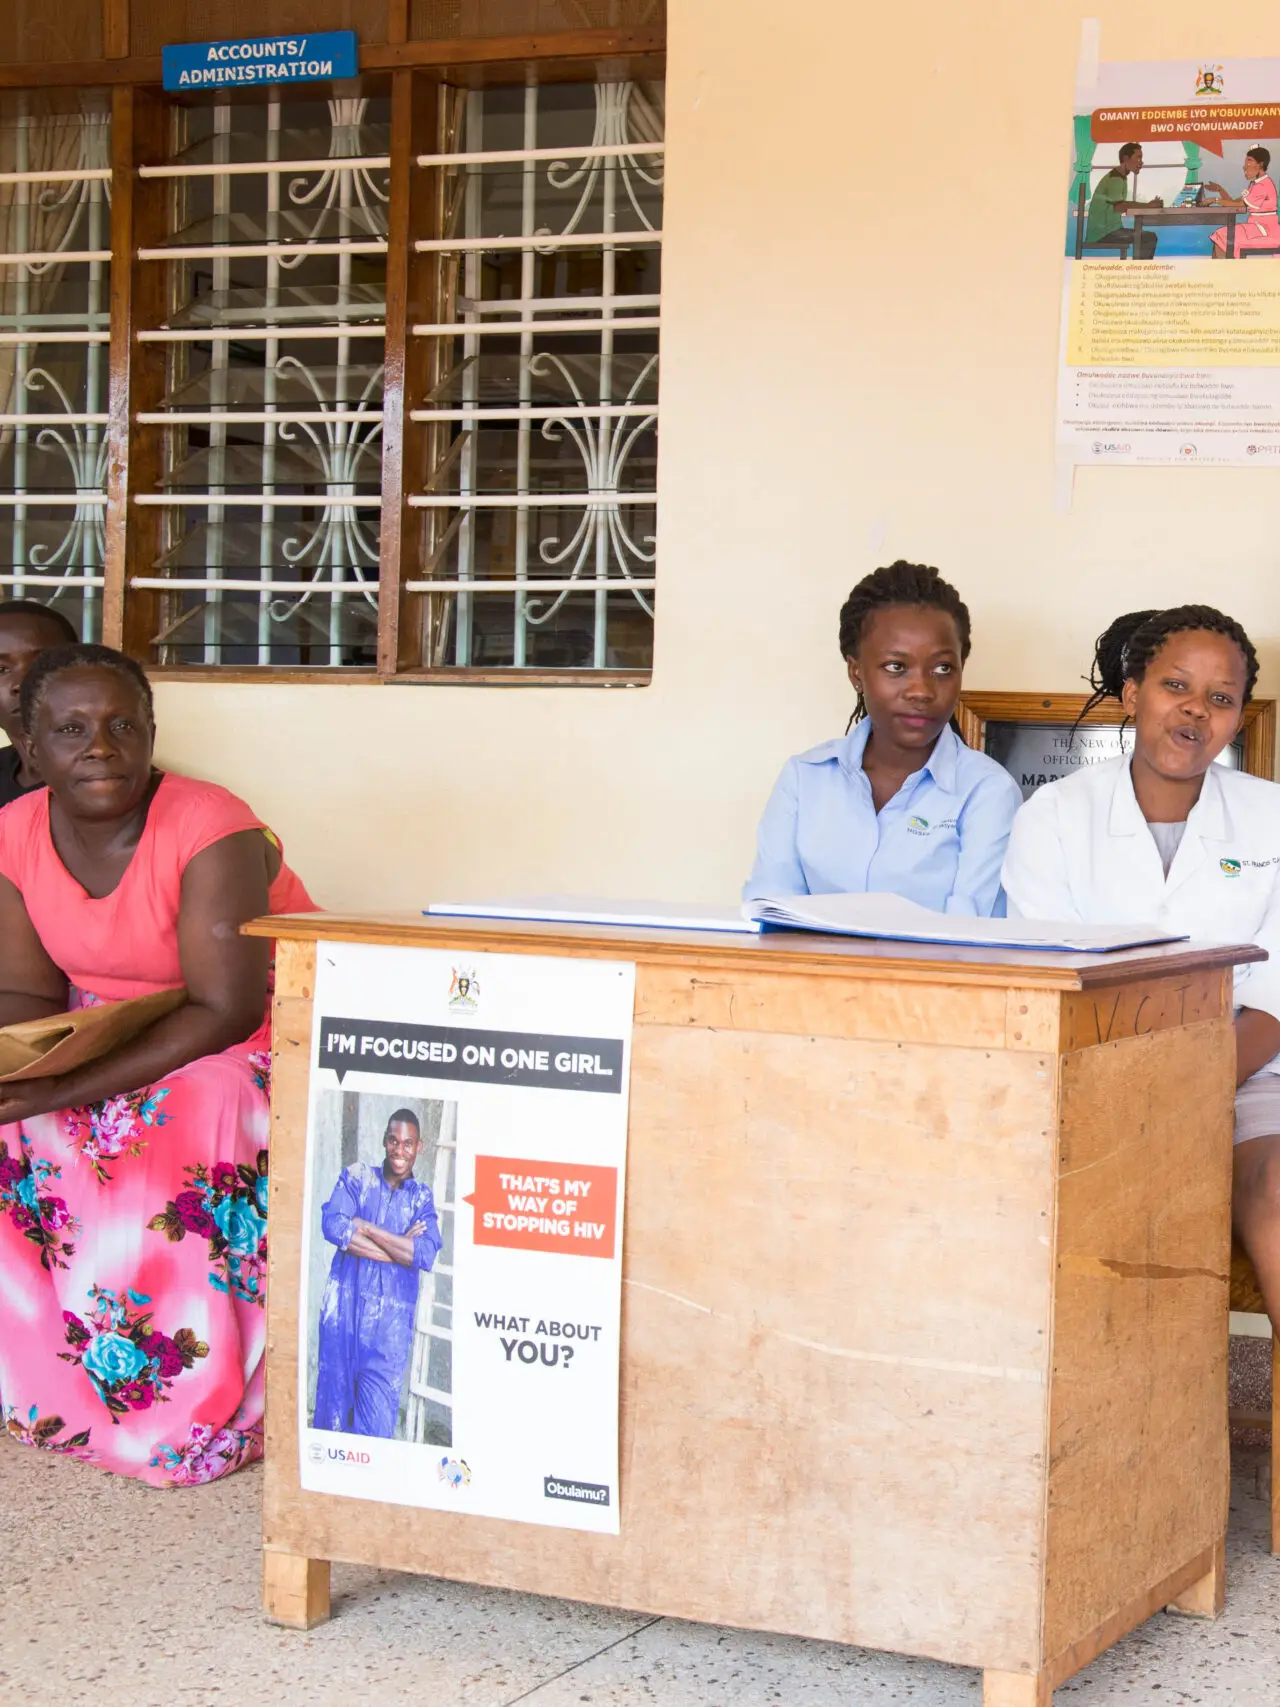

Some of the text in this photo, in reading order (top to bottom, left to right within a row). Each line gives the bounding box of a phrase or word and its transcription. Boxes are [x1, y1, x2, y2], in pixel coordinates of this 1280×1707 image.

[207, 39, 307, 62] ACCOUNTS/
[1099, 111, 1139, 121] OMANYI
[1141, 110, 1188, 120] EDDEMBE
[1190, 109, 1207, 118] LYO
[1150, 123, 1174, 133] BWO
[1080, 739, 1105, 748] NEW
[1043, 755, 1108, 765] OFFICIAL
[327, 1032, 613, 1076] I'M FOCUSED ON ONE GIRL.
[499, 1173, 592, 1198] THAT'S MY
[507, 1195, 578, 1215] WAY OF
[483, 1212, 606, 1240] STOPPING HIV
[474, 1311, 602, 1342] WHAT ABOUT
[500, 1337, 574, 1369] YOU?
[327, 1447, 371, 1465] USAID
[546, 1481, 607, 1502] Obulamu?
